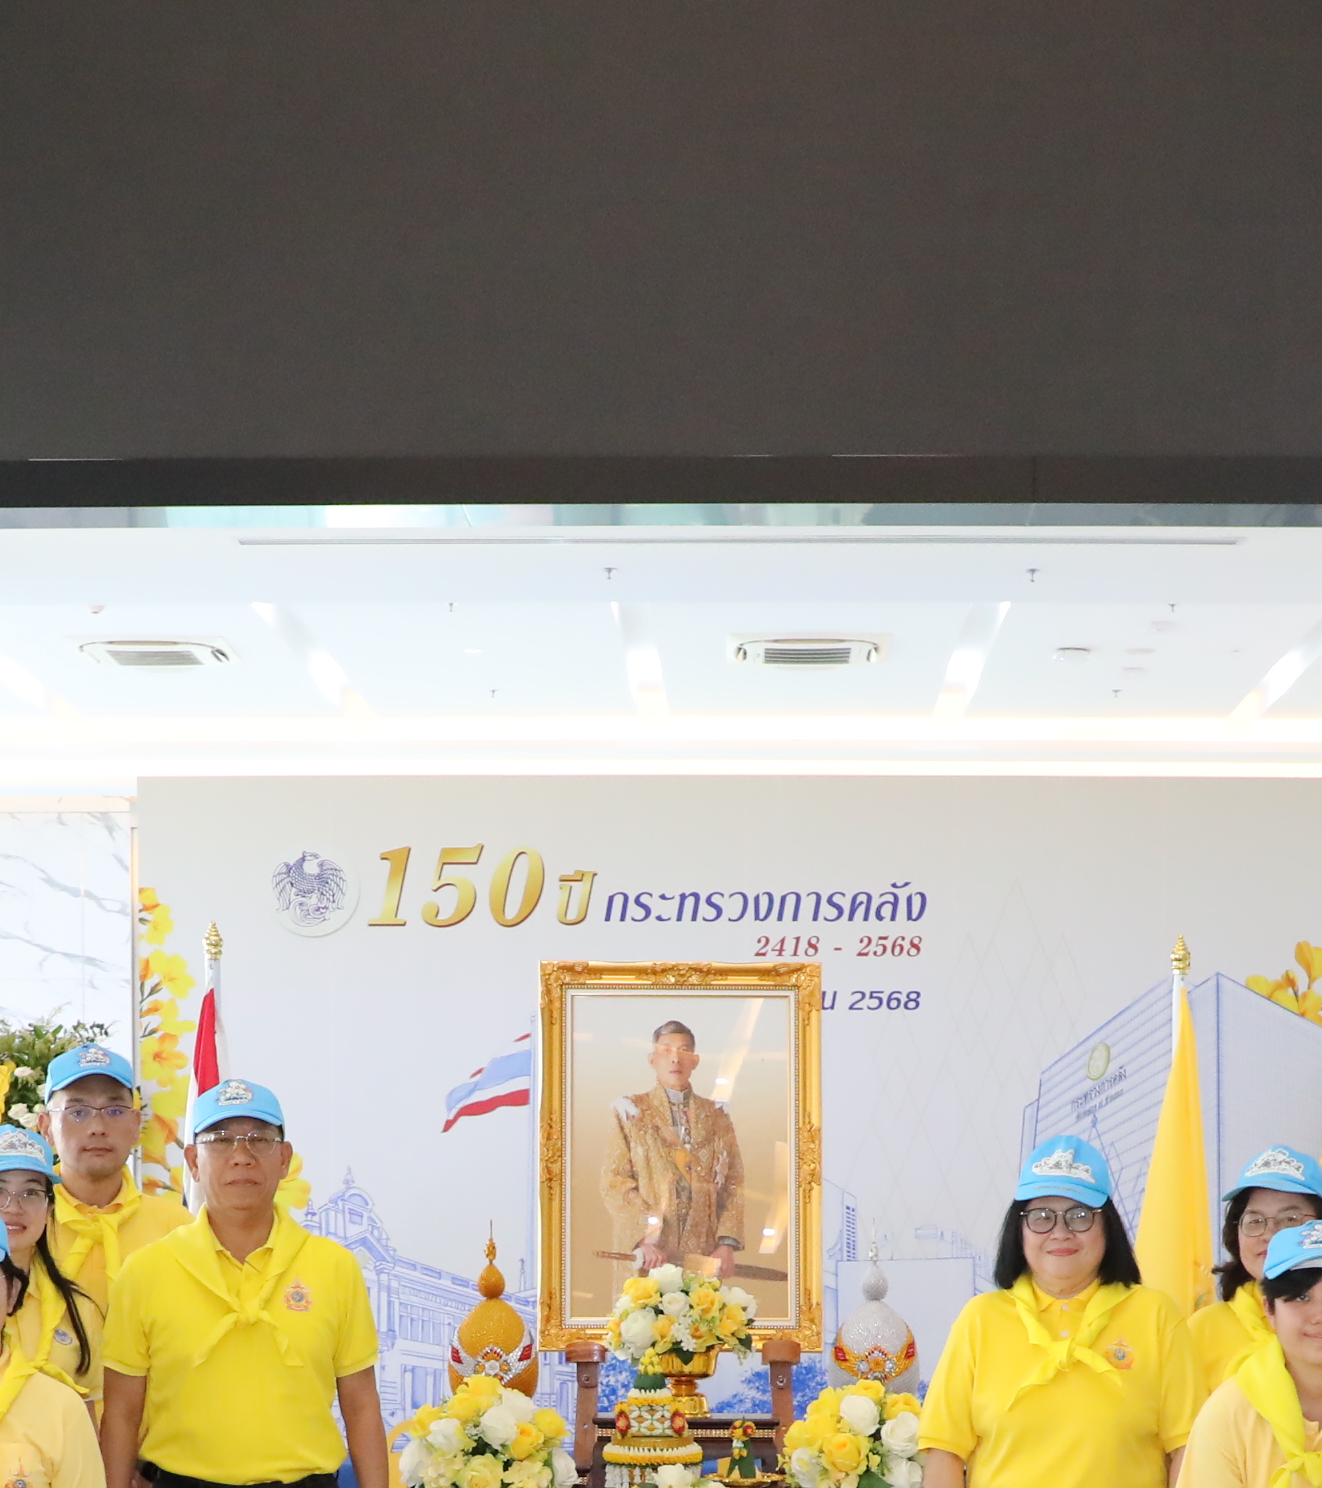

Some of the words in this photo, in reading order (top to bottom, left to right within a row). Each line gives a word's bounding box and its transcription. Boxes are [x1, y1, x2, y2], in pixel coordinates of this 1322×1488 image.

[367, 843, 545, 928] 150
[556, 870, 598, 926] ปี
[603, 881, 928, 923] กระทรวงการคลัง
[753, 935, 821, 958] 2418
[856, 935, 923, 958] 2568
[848, 990, 922, 1011] 2568
